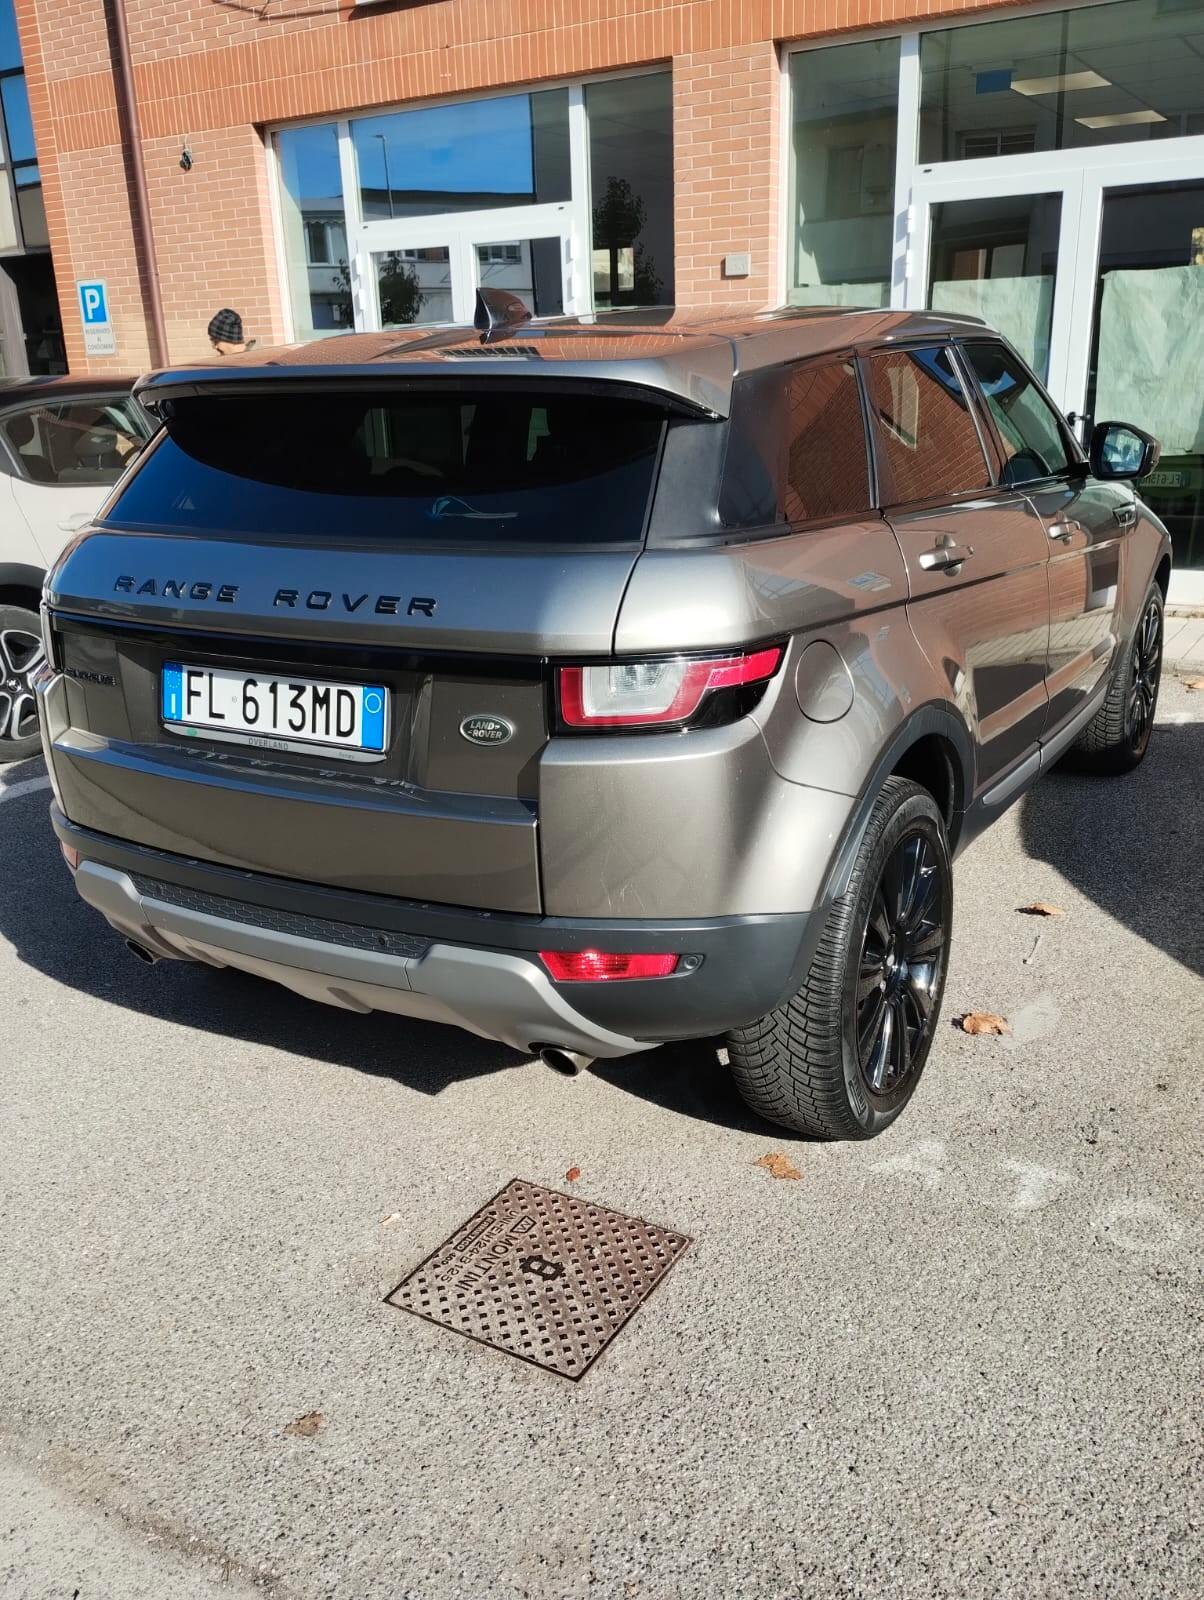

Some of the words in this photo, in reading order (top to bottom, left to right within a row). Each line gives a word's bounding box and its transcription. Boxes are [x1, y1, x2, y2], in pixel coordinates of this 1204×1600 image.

[84, 288, 101, 320] P
[113, 575, 241, 603] RANGE
[273, 588, 438, 617] ROVER
[187, 670, 225, 720] FL
[242, 678, 356, 738] 613MD
[470, 720, 495, 730] LAND
[472, 729, 503, 739] ROVER
[248, 737, 289, 751] OVERLAND
[454, 1233, 519, 1291] MONTINI
